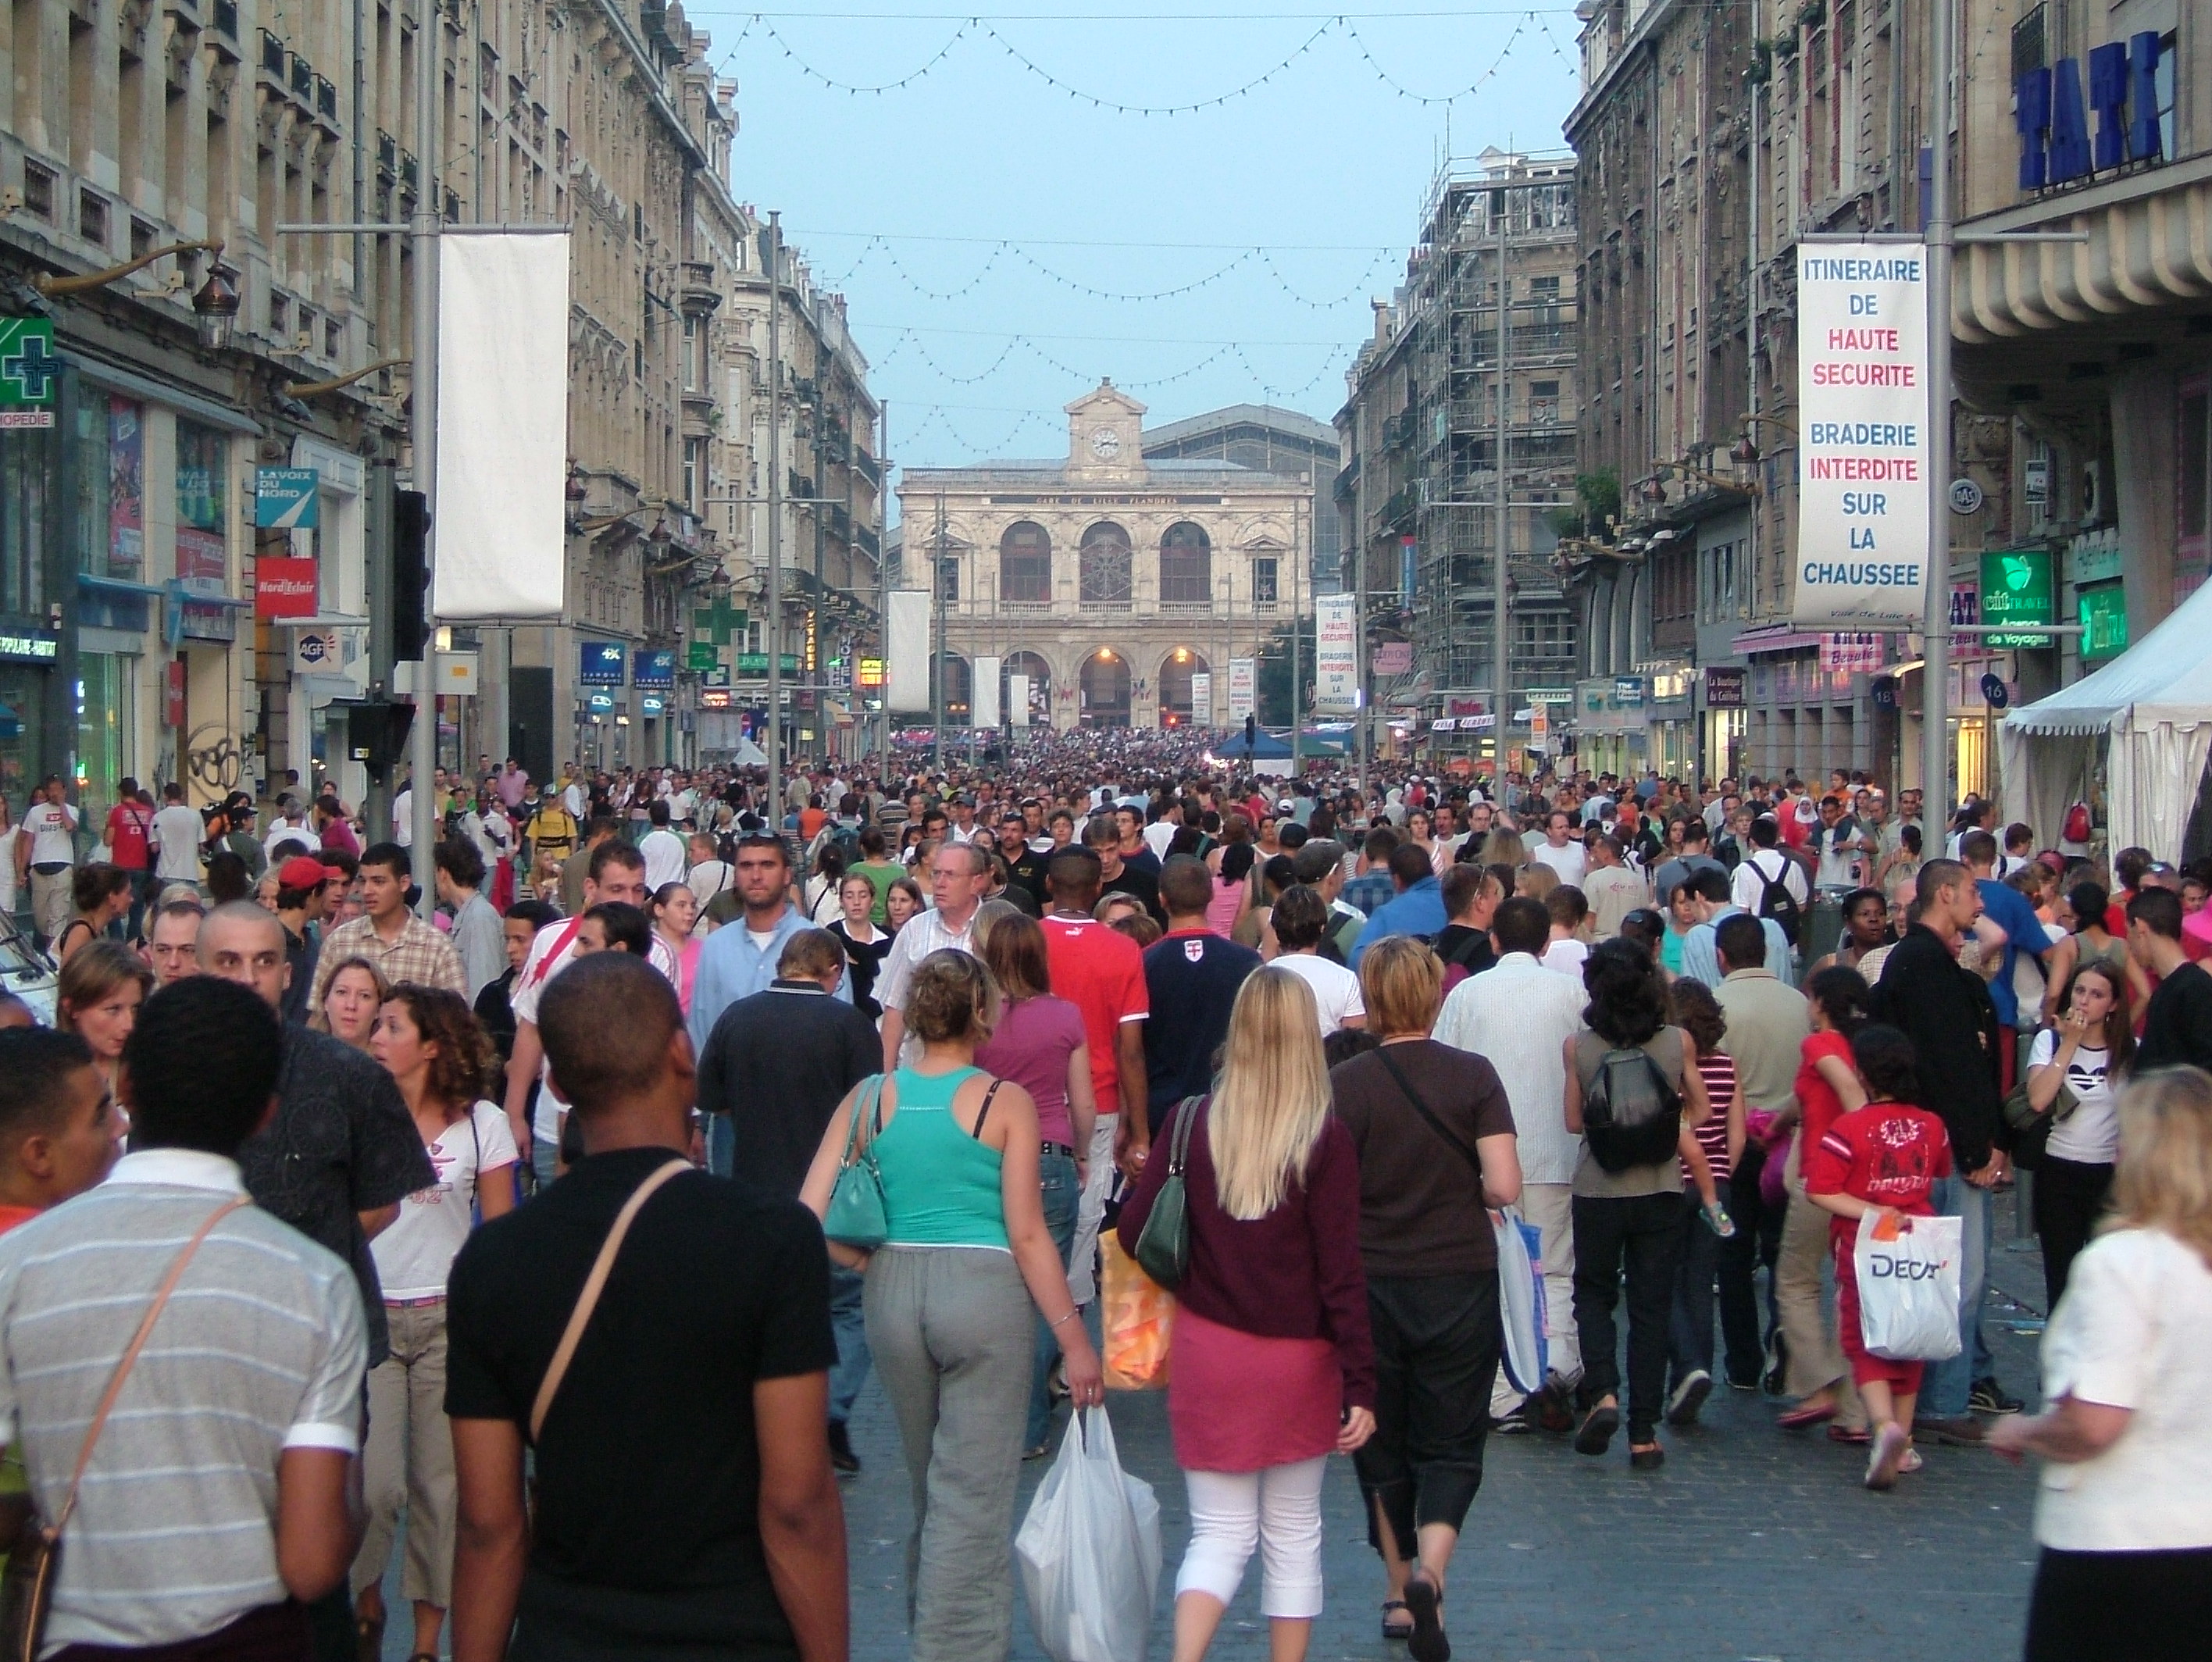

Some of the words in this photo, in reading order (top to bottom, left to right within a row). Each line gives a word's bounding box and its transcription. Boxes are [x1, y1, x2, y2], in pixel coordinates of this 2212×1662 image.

[1803, 259, 1921, 282] ITINERAIRE
[1849, 294, 1878, 316] DE
[1828, 328, 1899, 351] HAUTE
[1813, 362, 1916, 387] SECURITE
[0, 414, 50, 426] OPEDIE
[1811, 423, 1918, 447] BRADERIE
[278, 471, 312, 480] VOIX
[1810, 458, 1918, 481] INTERDITE
[259, 489, 300, 498] NORD
[1843, 492, 1886, 515] SUR
[1850, 527, 1875, 549] LA
[1803, 562, 1919, 586] CHAUSSEE
[1320, 633, 1353, 642] SECURITE
[1987, 634, 2002, 644] de
[300, 644, 323, 654] AGF
[1831, 648, 1873, 664] Beauté
[1329, 674, 1343, 683] SUR
[1876, 691, 1891, 703] 18
[1985, 685, 2002, 699] 16
